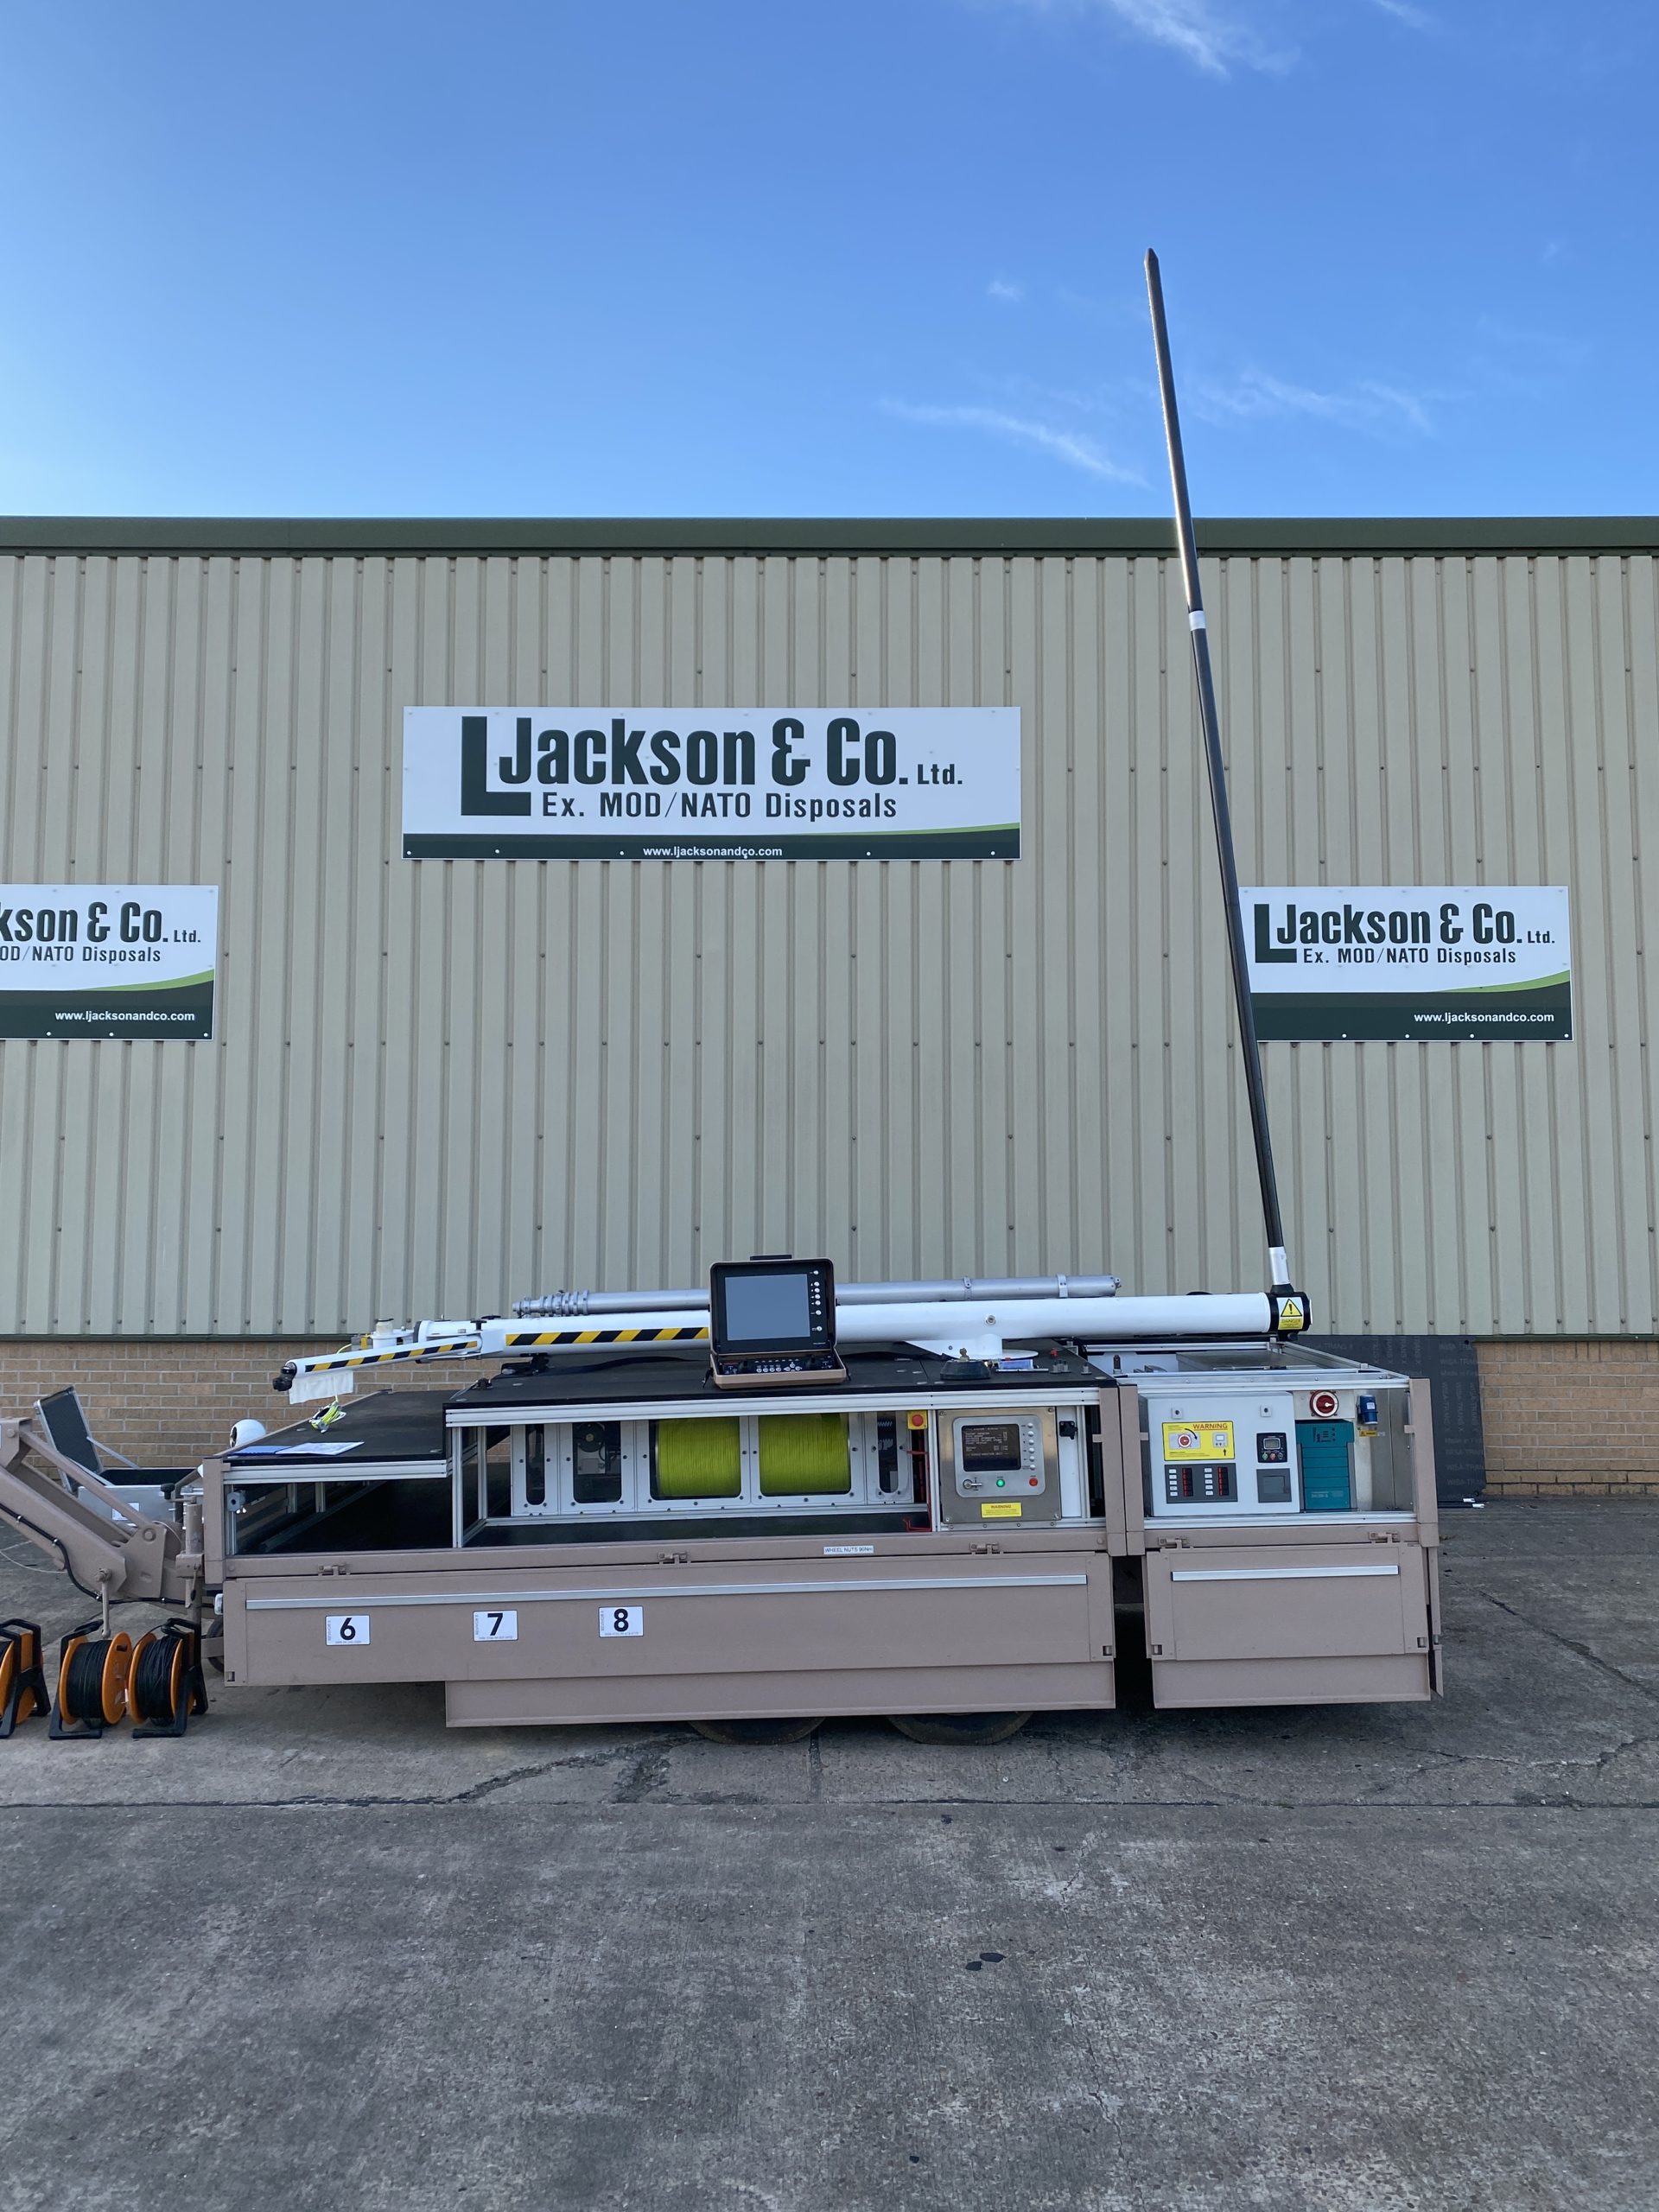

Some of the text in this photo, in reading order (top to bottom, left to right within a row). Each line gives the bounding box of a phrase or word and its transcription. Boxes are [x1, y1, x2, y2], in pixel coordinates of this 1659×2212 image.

[772, 718, 810, 785] &
[827, 718, 908, 785] Co.
[918, 764, 962, 785] Ltd.
[543, 792, 896, 823] Ex. MOD/NATO Disposals
[643, 847, 782, 859] www.ljacksonandco.com
[87, 902, 110, 942] &
[120, 902, 168, 942] Co.
[175, 931, 200, 943] Ltd.
[1440, 904, 1464, 944] &
[1473, 904, 1522, 944] Co.
[1528, 931, 1554, 944] Ltd.
[83, 946, 160, 964] Disposals
[1304, 948, 1516, 966] Ex. MOD/NATO Disposals
[55, 1011, 195, 1022] www.ljacksonandco.com
[1414, 1012, 1554, 1023] www.ljacksonandco.com
[340, 1617, 356, 1640] 6
[487, 1612, 503, 1636] 7
[613, 1608, 629, 1632] 8
